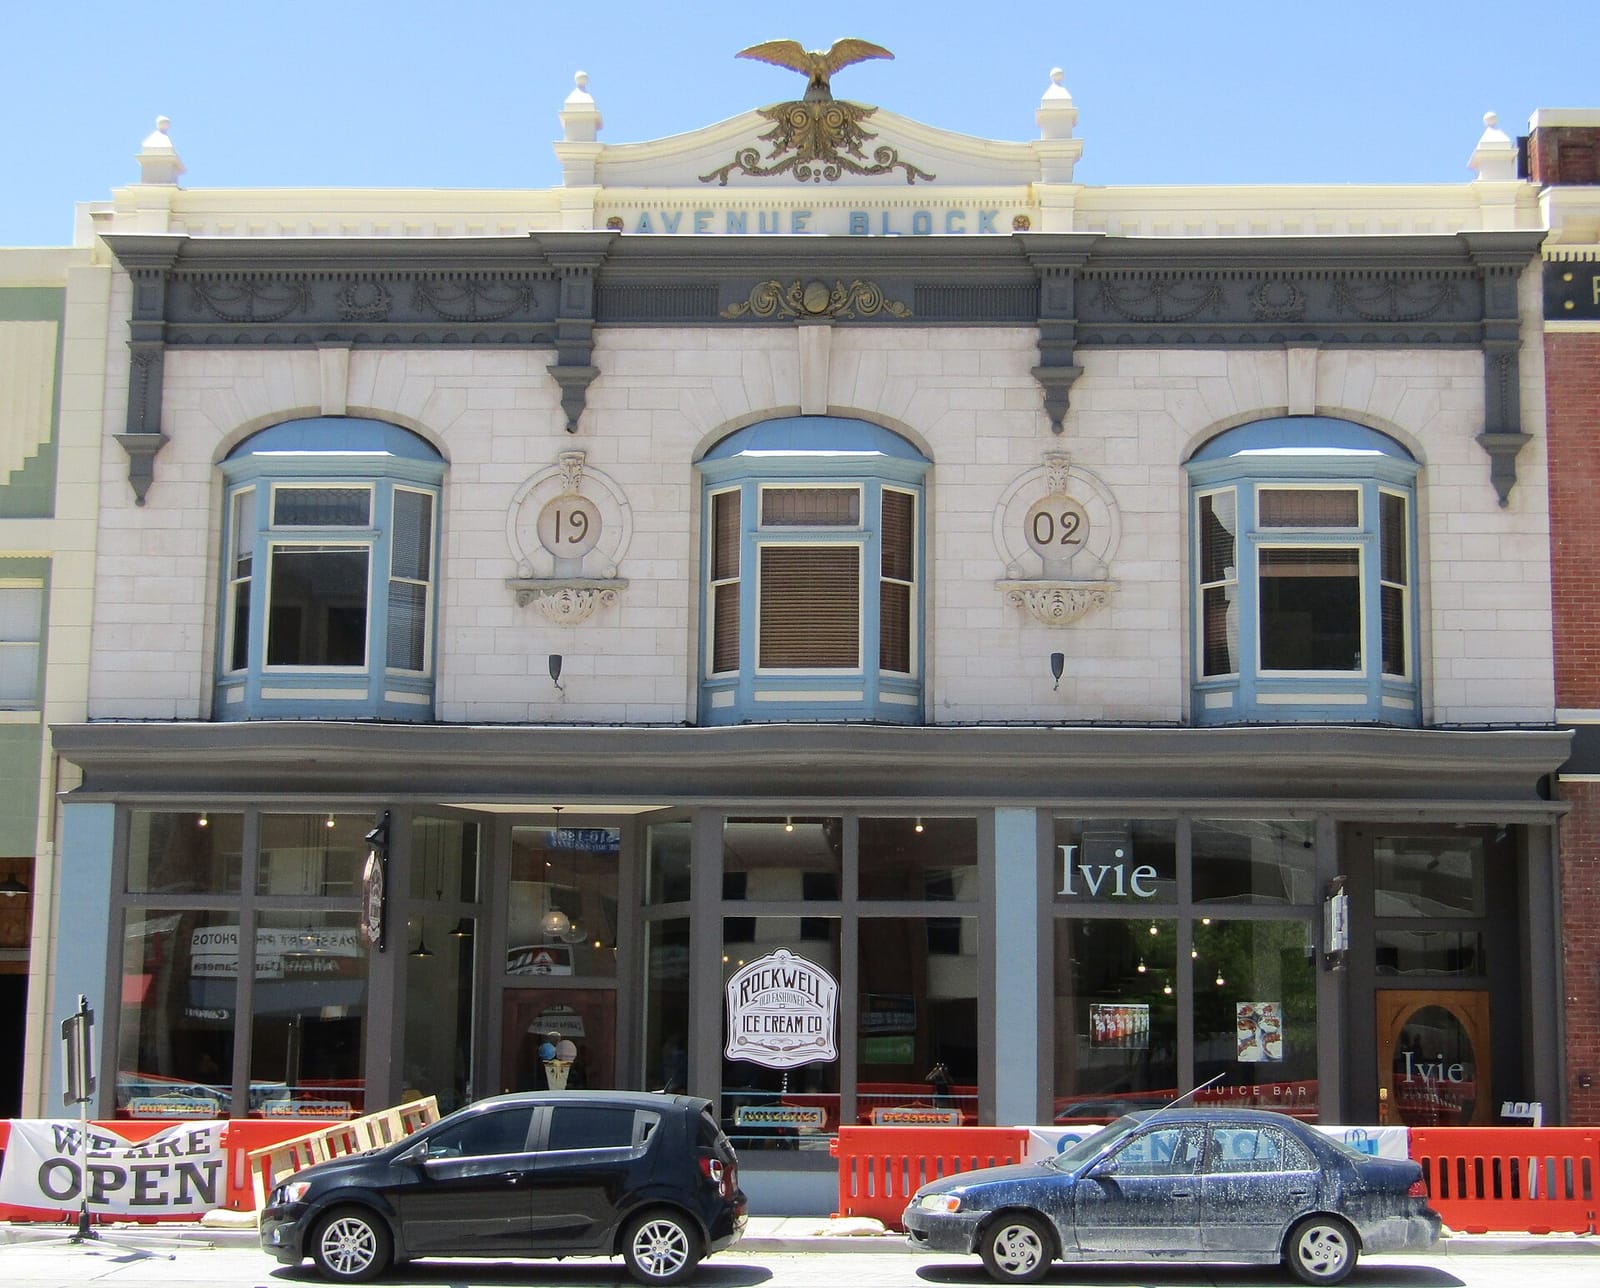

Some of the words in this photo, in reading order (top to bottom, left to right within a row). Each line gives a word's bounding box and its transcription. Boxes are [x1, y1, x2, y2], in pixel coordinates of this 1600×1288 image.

[635, 209, 813, 235] AVENUE
[849, 209, 1001, 237] BLOCK
[553, 509, 590, 544] 19
[1032, 511, 1082, 546] 02
[1057, 845, 1158, 897] Ivie
[740, 968, 824, 1008] ROCKWELL
[760, 995, 771, 1006] OLD
[771, 992, 805, 1006] FASHIONED
[743, 1015, 760, 1033] ICE
[764, 1015, 803, 1033] CREAM
[807, 1016, 822, 1034] CO
[1401, 1051, 1465, 1083] Ivie
[1205, 1085, 1261, 1095] JUICE
[1273, 1086, 1307, 1096] BAR
[271, 1105, 293, 1116] ICE
[298, 1105, 344, 1117] CREAM
[743, 1110, 818, 1123] NOVELTIES
[882, 1112, 951, 1123] DESSERTS
[52, 1124, 117, 1158] WE
[38, 1157, 223, 1205] OPEN
